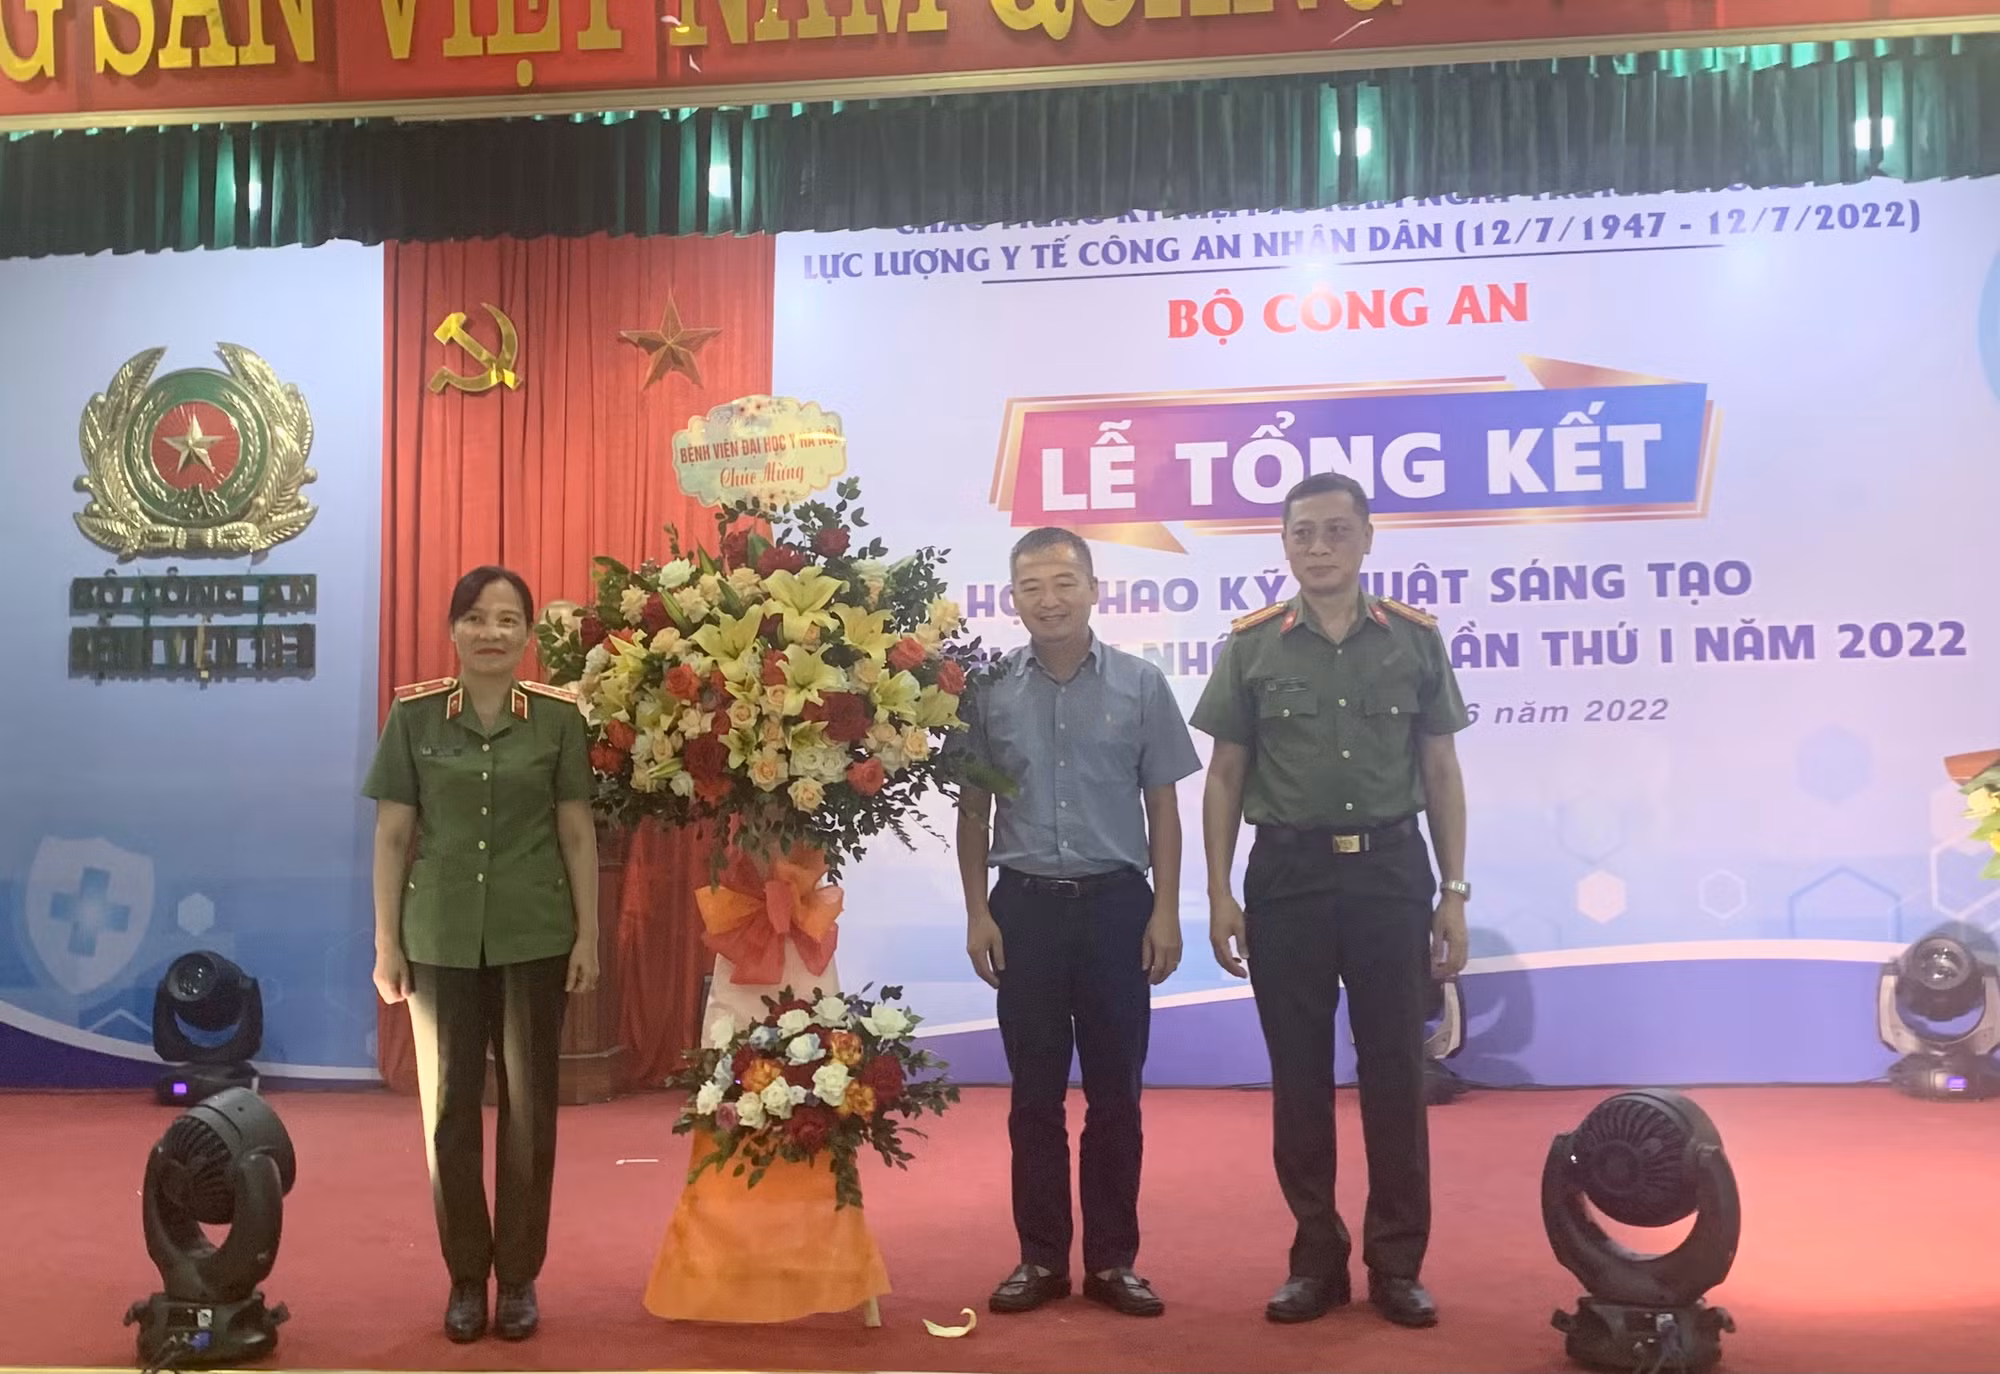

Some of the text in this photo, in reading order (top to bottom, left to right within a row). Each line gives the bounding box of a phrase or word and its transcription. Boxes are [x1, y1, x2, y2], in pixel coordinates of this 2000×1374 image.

[804, 251, 864, 285] LỰC
[875, 246, 990, 282] LƯỢNG
[1000, 244, 1022, 271] Y
[1031, 234, 1072, 269] TẾ
[1078, 234, 1181, 266] CÔNG
[1192, 233, 1242, 261] AN
[1253, 224, 1357, 259] NHÂN
[1369, 218, 1443, 253] DÂN
[1455, 210, 1667, 254] (12/7/1947
[1708, 198, 1922, 236] 12/7/2022)
[1168, 281, 1529, 347] BỘ CÔNG AN
[713, 438, 739, 462] VIỆN
[741, 438, 762, 459] ĐẠI
[764, 434, 787, 455] HỌC
[1041, 419, 1137, 513] LỄ
[1487, 401, 1663, 495] KẾT
[720, 467, 757, 489] Chúc
[1097, 577, 1199, 614] HAO
[1220, 568, 1289, 610] KỸ
[1359, 562, 1469, 614] UẬT
[1490, 558, 1626, 603] SÁNG
[1647, 560, 1752, 606] TẠO
[1451, 620, 1519, 669] ẦN
[1541, 621, 1640, 667] THỨ
[1660, 627, 1673, 664] I
[1694, 617, 1816, 663] NĂM
[1837, 620, 1968, 659] 2022
[1494, 700, 1570, 725] năm
[1584, 697, 1670, 723] 2022
